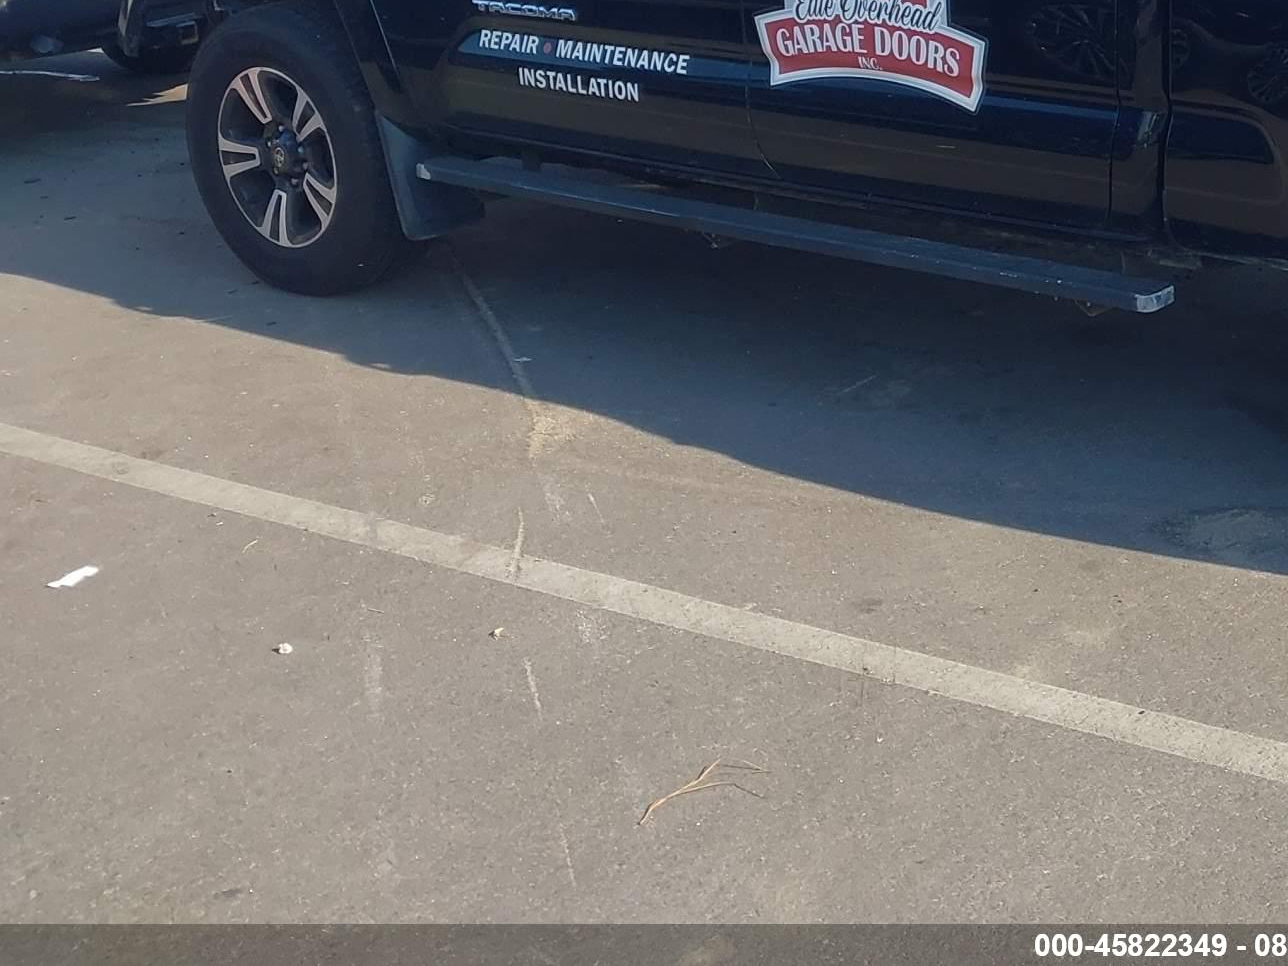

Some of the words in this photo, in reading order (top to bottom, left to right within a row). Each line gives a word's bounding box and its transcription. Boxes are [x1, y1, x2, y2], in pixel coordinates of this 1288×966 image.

[479, 29, 540, 55] REPAIR
[555, 39, 690, 74] MAINTENANCE
[776, 23, 867, 56] GARAGE
[874, 26, 960, 77] DOORS
[858, 56, 883, 71] INC.
[518, 67, 640, 102] INSTALLATION
